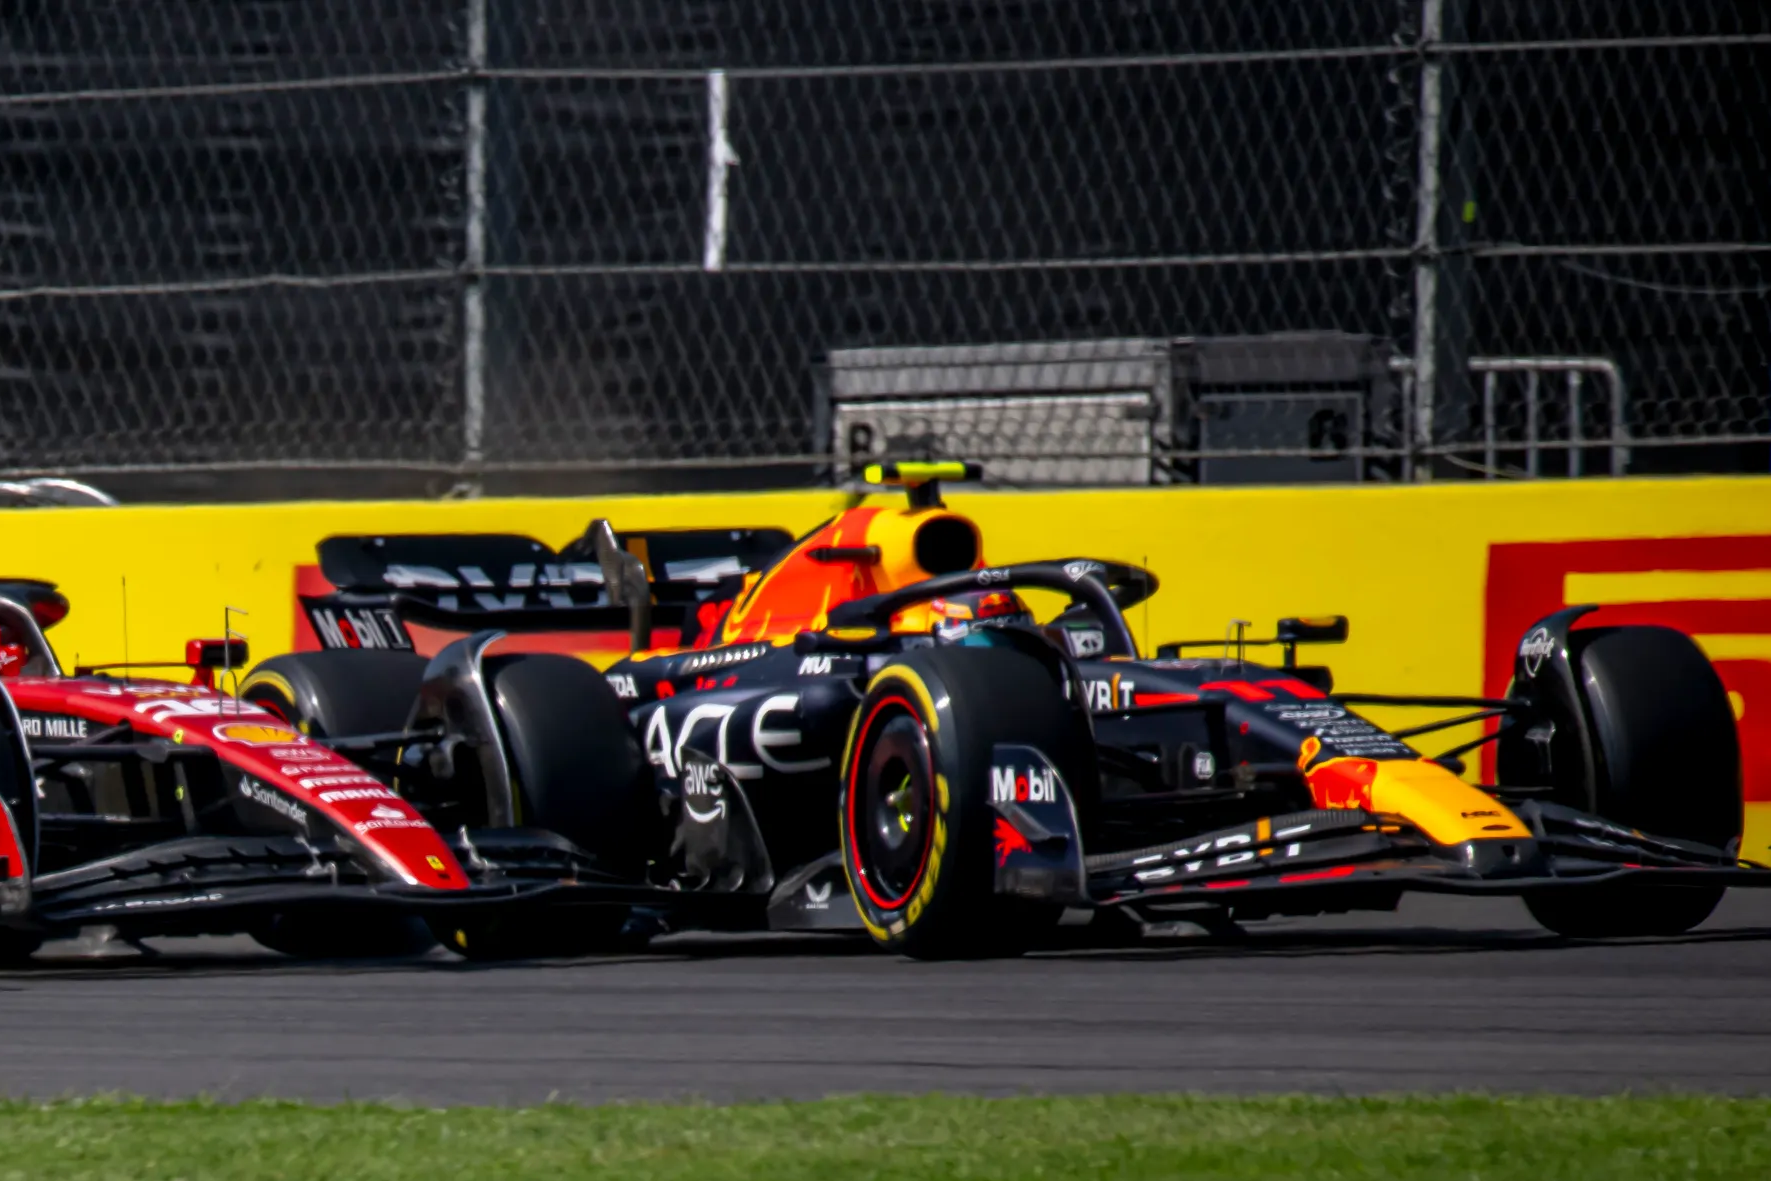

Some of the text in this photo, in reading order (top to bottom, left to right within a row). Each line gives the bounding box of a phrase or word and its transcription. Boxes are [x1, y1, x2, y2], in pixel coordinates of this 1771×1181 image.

[313, 608, 388, 649] Mobil
[1198, 679, 1327, 703] 11
[45, 717, 88, 738] MILLE
[992, 766, 1057, 802] Mobil
